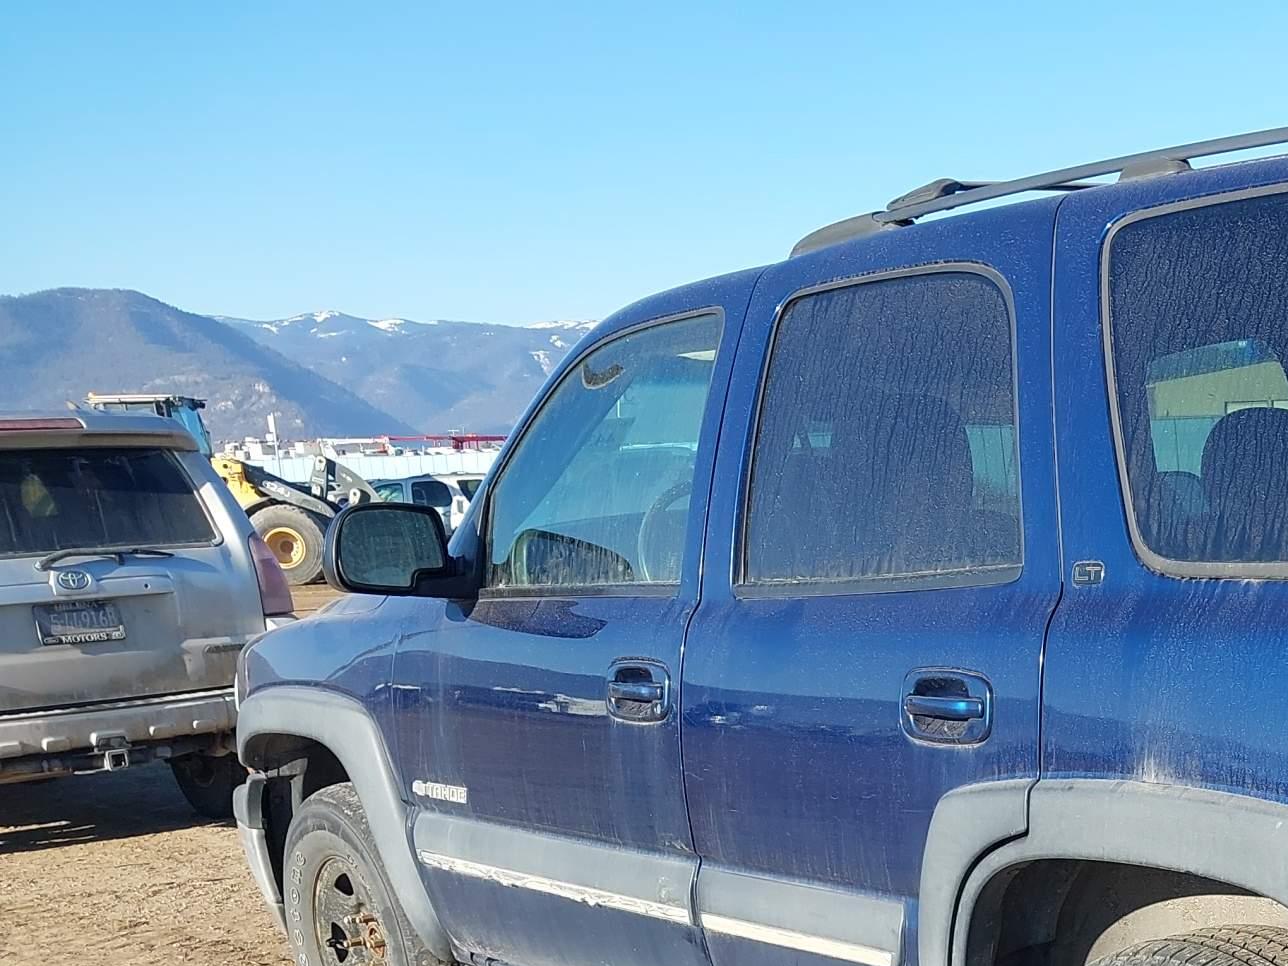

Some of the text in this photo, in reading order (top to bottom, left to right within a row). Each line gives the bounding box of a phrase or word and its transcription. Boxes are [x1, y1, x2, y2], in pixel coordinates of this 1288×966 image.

[1074, 566, 1102, 581] LT
[62, 633, 107, 643] MOTORS
[427, 782, 467, 804] TAHOE
